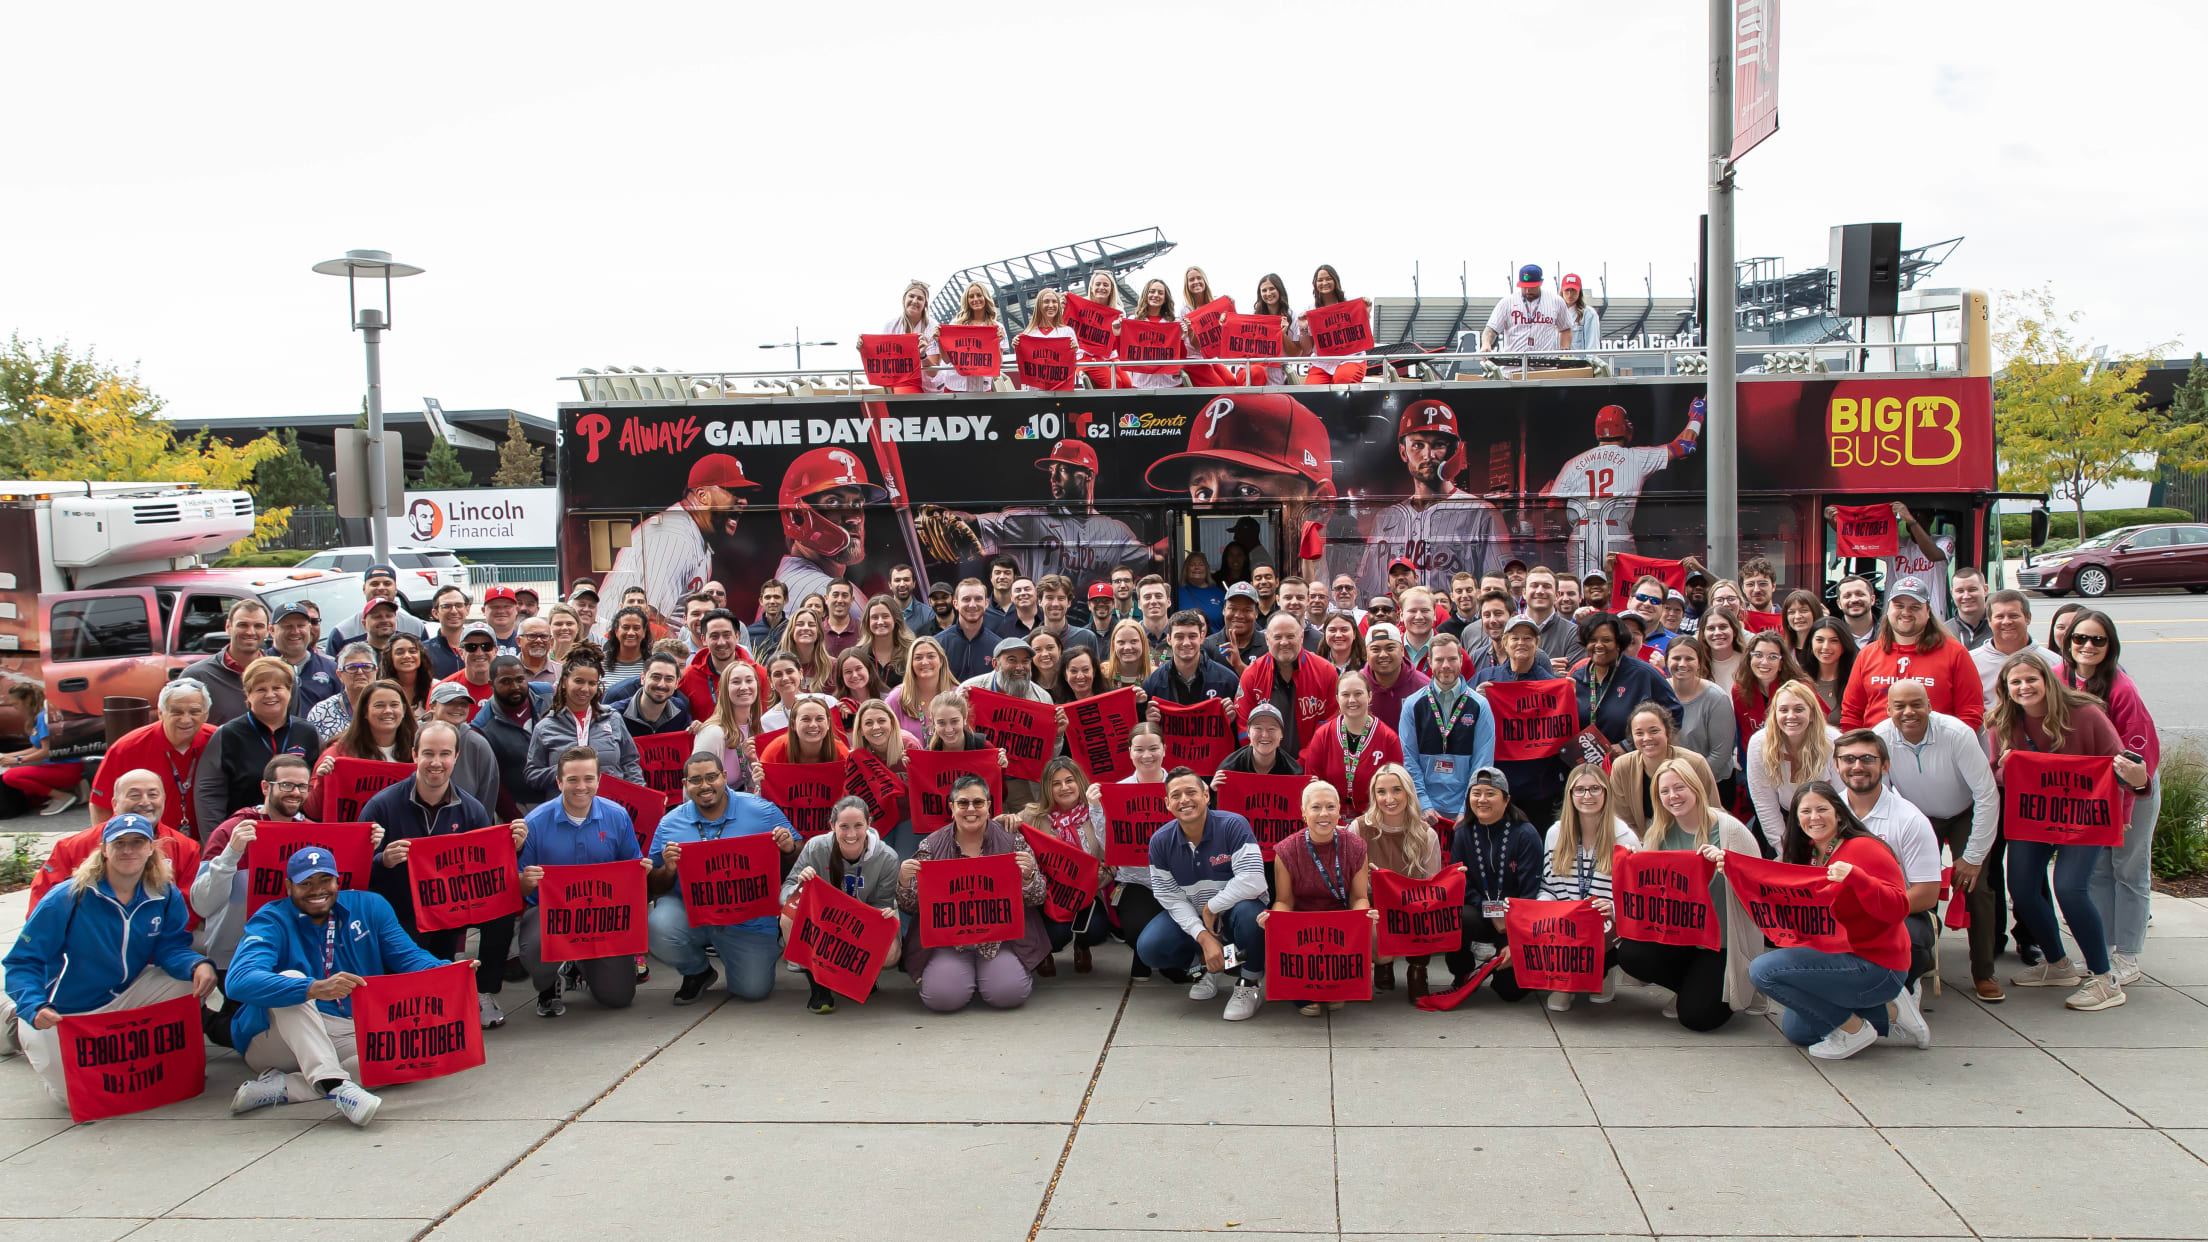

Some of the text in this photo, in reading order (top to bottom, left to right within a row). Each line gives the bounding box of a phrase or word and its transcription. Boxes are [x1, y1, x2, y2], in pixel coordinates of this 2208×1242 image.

[1511, 310, 1554, 325] Phillies
[1601, 333, 1695, 350] ncial Field
[960, 352, 992, 367] OCTOBER
[1139, 413, 1187, 429] Sports
[1831, 397, 1902, 433] BIG
[704, 420, 800, 446] GAME
[808, 418, 873, 444] DAY
[881, 415, 999, 442] READY.
[1087, 424, 1110, 438] 62
[1120, 428, 1182, 437] PHILADELPHIA
[1575, 450, 1626, 472] SCHWARBER
[1831, 434, 1902, 467] BUS
[1585, 468, 1614, 500] 12
[448, 499, 524, 521] Lincoln
[450, 523, 514, 537] Financial
[1516, 693, 1557, 713] RALLY FOR
[992, 707, 1034, 730] RALLY FOR
[1107, 713, 1129, 736] RALLY
[1206, 714, 1225, 738] RED
[1503, 714, 1573, 741] RED OCTOBER
[996, 731, 1044, 761] OCTOBER
[1076, 703, 1114, 775] RED OCTOBER
[1188, 743, 1210, 761] RALLY
[355, 775, 385, 794] RALLY
[788, 783, 831, 801] RALLY FOR
[2040, 772, 2093, 792] RALLY FOR
[922, 791, 943, 816] RED
[1126, 796, 1151, 816] RALLY
[1245, 792, 1289, 813] RALLY FOR
[2018, 794, 2111, 827] RED OCTOBER
[1112, 819, 1133, 845] RED
[435, 846, 486, 872] RALLY FOR
[705, 853, 750, 876] RALLY FOR
[1039, 852, 1079, 881] RALLY FOR
[253, 867, 284, 896] RED
[418, 866, 507, 908] RED OCTOBER
[565, 880, 613, 903] RALLY FOR
[690, 874, 770, 907] RED OCTOBER
[949, 875, 994, 895] RALLY FOR
[1638, 868, 1689, 895] RALLY FOR
[1759, 884, 1813, 899] RALLY FOR
[1401, 885, 1447, 905] RALLY FOR
[547, 905, 631, 935] RED OCTOBER
[820, 906, 865, 940] RALLY FOR
[932, 898, 1013, 928] RED OCTOBER
[1387, 906, 1463, 935] RED OCTOBER
[1622, 891, 1707, 932] RED OCTOBER
[1777, 904, 1836, 937] OCTOBER
[1297, 926, 1345, 947] RALLY FOR
[1532, 917, 1577, 940] RALLY FOR
[819, 932, 871, 975] OCTOBER
[1280, 952, 1364, 980] RED OCTOBER
[1522, 943, 1595, 974] RED OCTOBER
[388, 996, 444, 1024] RALLY FOR
[75, 1020, 186, 1068] RED OCTOBER
[366, 1020, 466, 1062] RED OCTOBER
[103, 1061, 163, 1093] RALLY FOR
